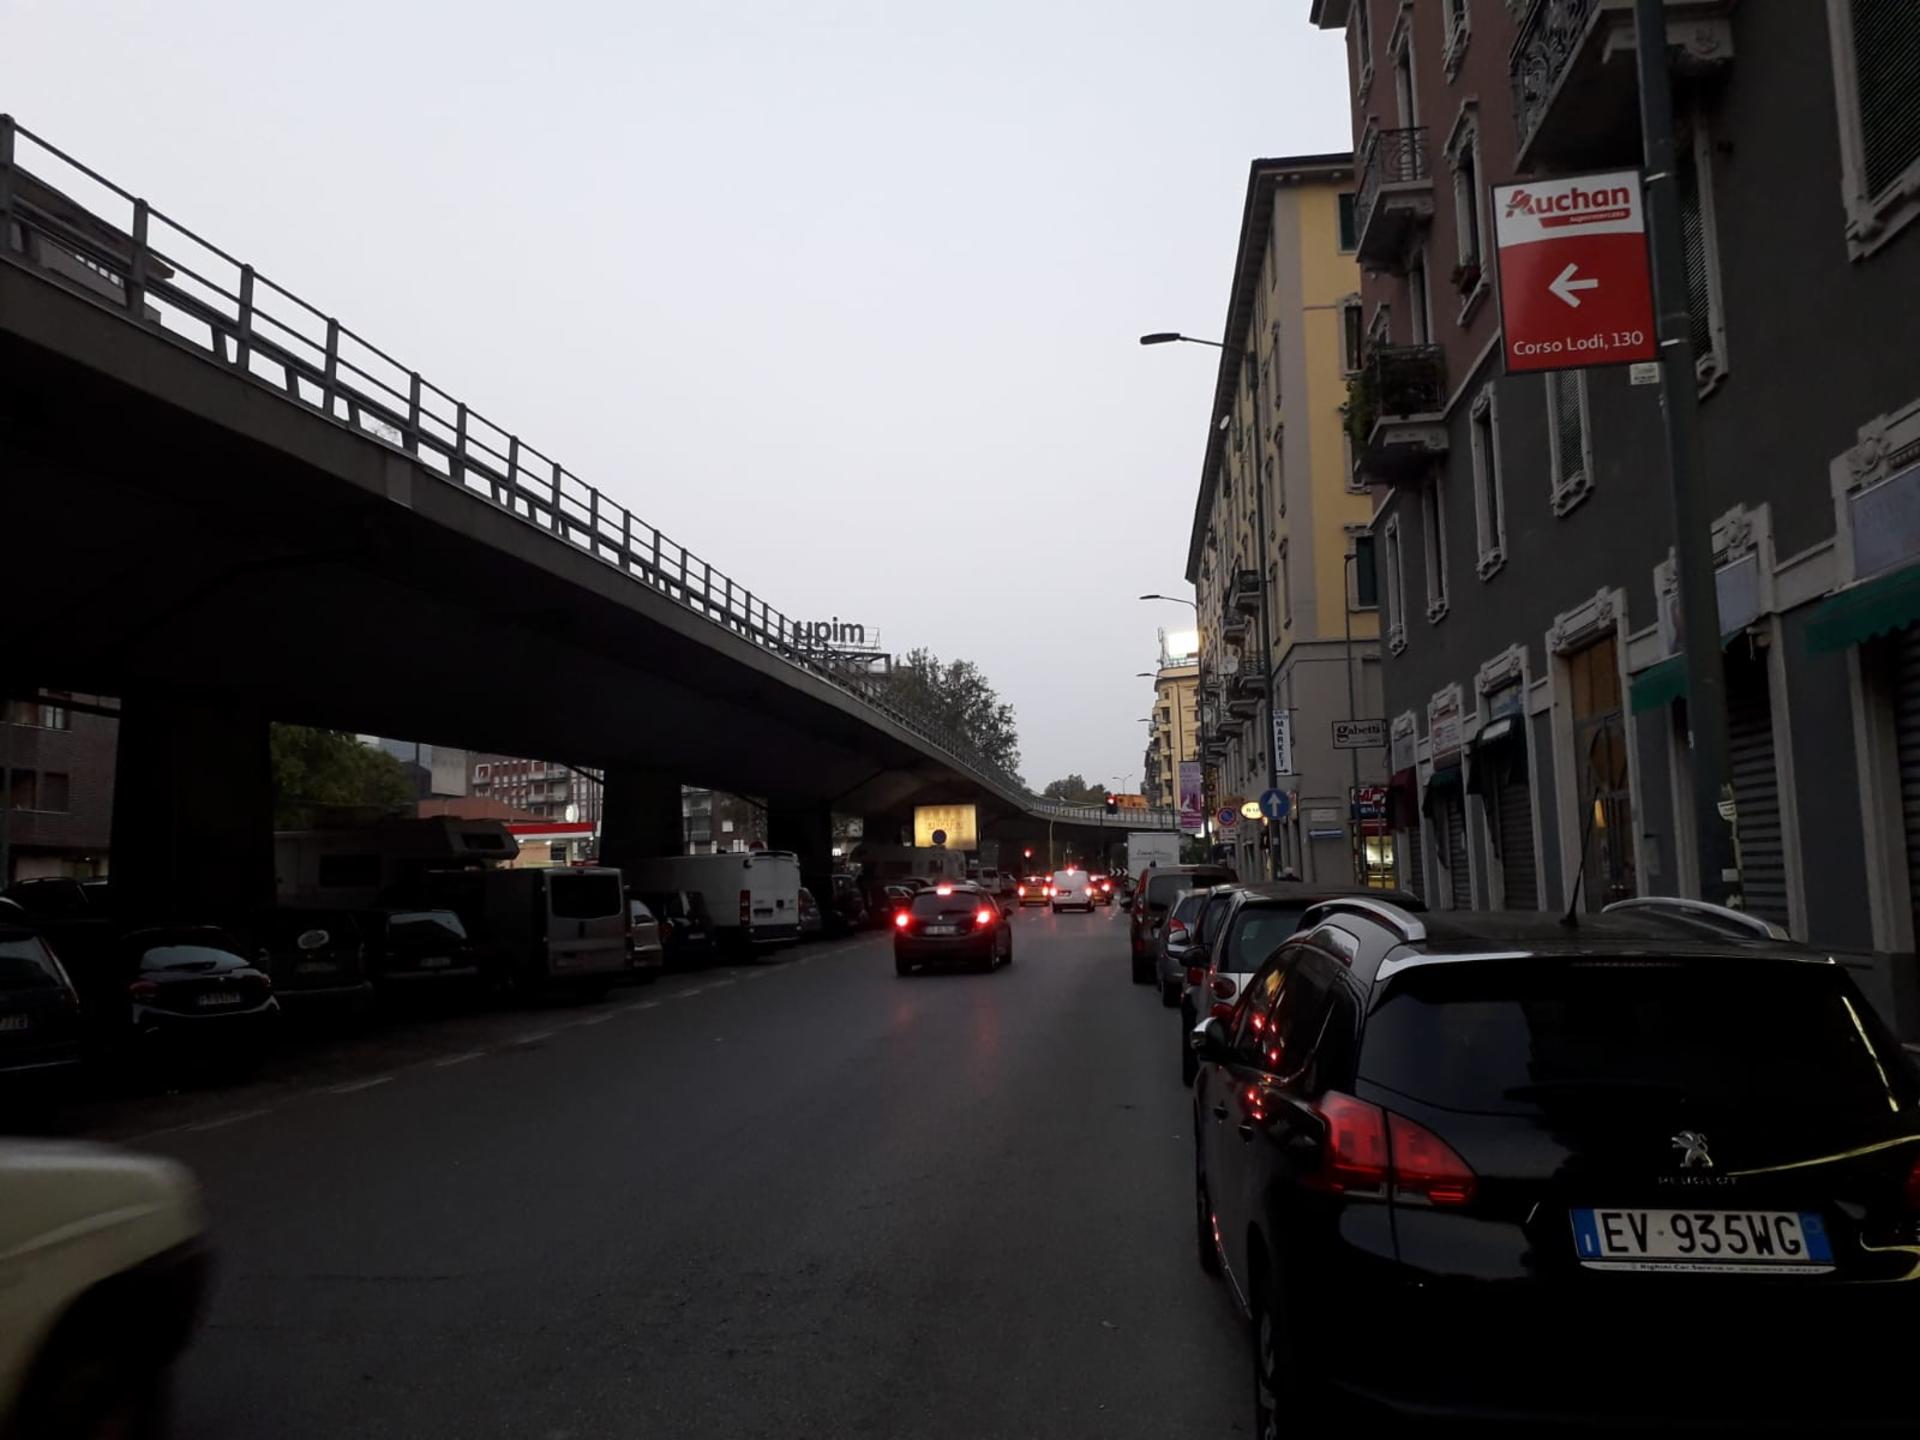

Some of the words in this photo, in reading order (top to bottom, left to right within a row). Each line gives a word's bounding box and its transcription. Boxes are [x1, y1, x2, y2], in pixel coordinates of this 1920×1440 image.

[1505, 187, 1630, 218] Auchan
[1513, 340, 1563, 355] Corso
[1566, 333, 1609, 352] Lodi,
[1611, 330, 1644, 347] 130
[793, 616, 865, 647] upim
[1275, 720, 1285, 768] MARKET
[1601, 1212, 1649, 1253] EV
[1670, 1213, 1801, 1256] 935WG
